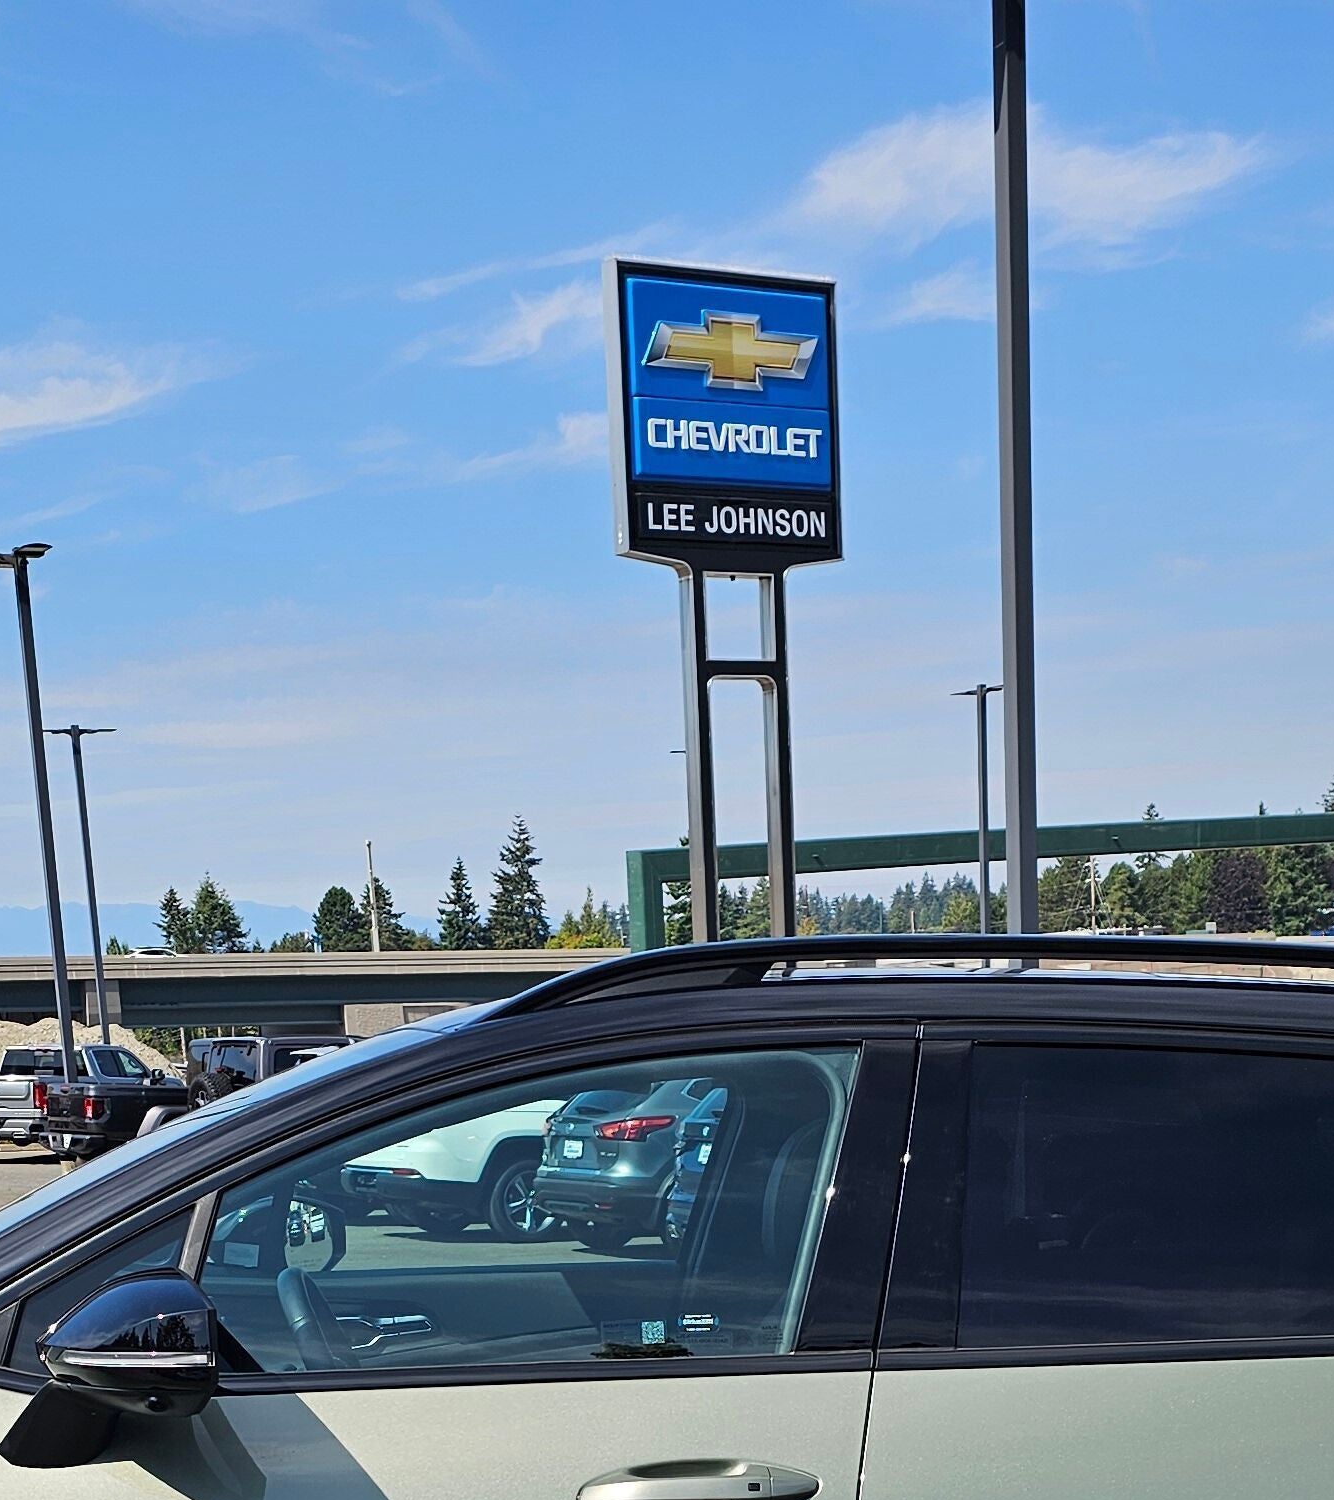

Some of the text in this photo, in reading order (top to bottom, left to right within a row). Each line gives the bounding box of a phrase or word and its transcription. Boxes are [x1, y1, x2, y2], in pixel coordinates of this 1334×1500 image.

[647, 417, 822, 459] CHEVROLET
[647, 502, 827, 538] LEE JOHNSON
